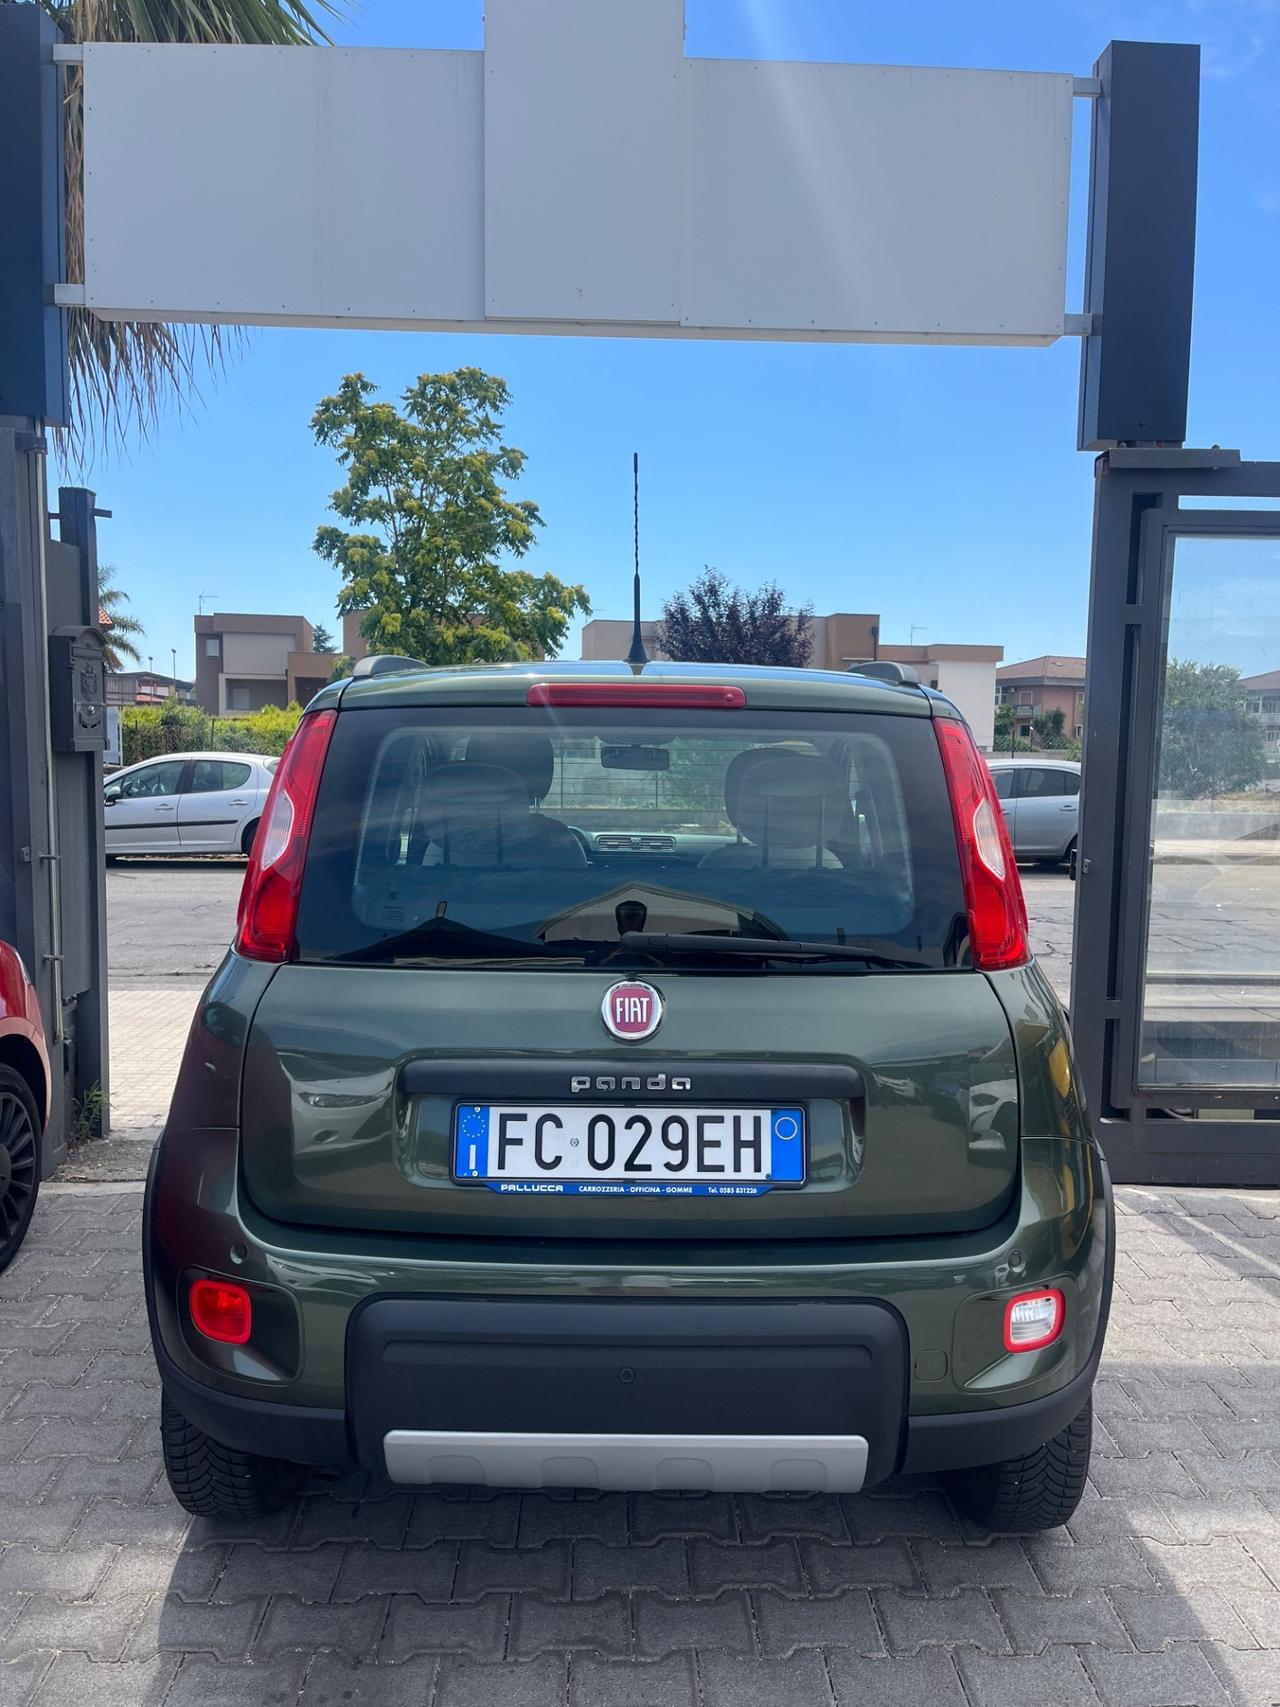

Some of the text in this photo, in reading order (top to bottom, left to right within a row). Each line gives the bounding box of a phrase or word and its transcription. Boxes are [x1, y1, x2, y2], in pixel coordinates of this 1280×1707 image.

[615, 997, 650, 1023] FIAT
[571, 1074, 691, 1093] panda
[497, 1113, 761, 1173] FC 029EH
[500, 1184, 564, 1192] PALLUCCA
[578, 1185, 625, 1193] CARROZZERIA
